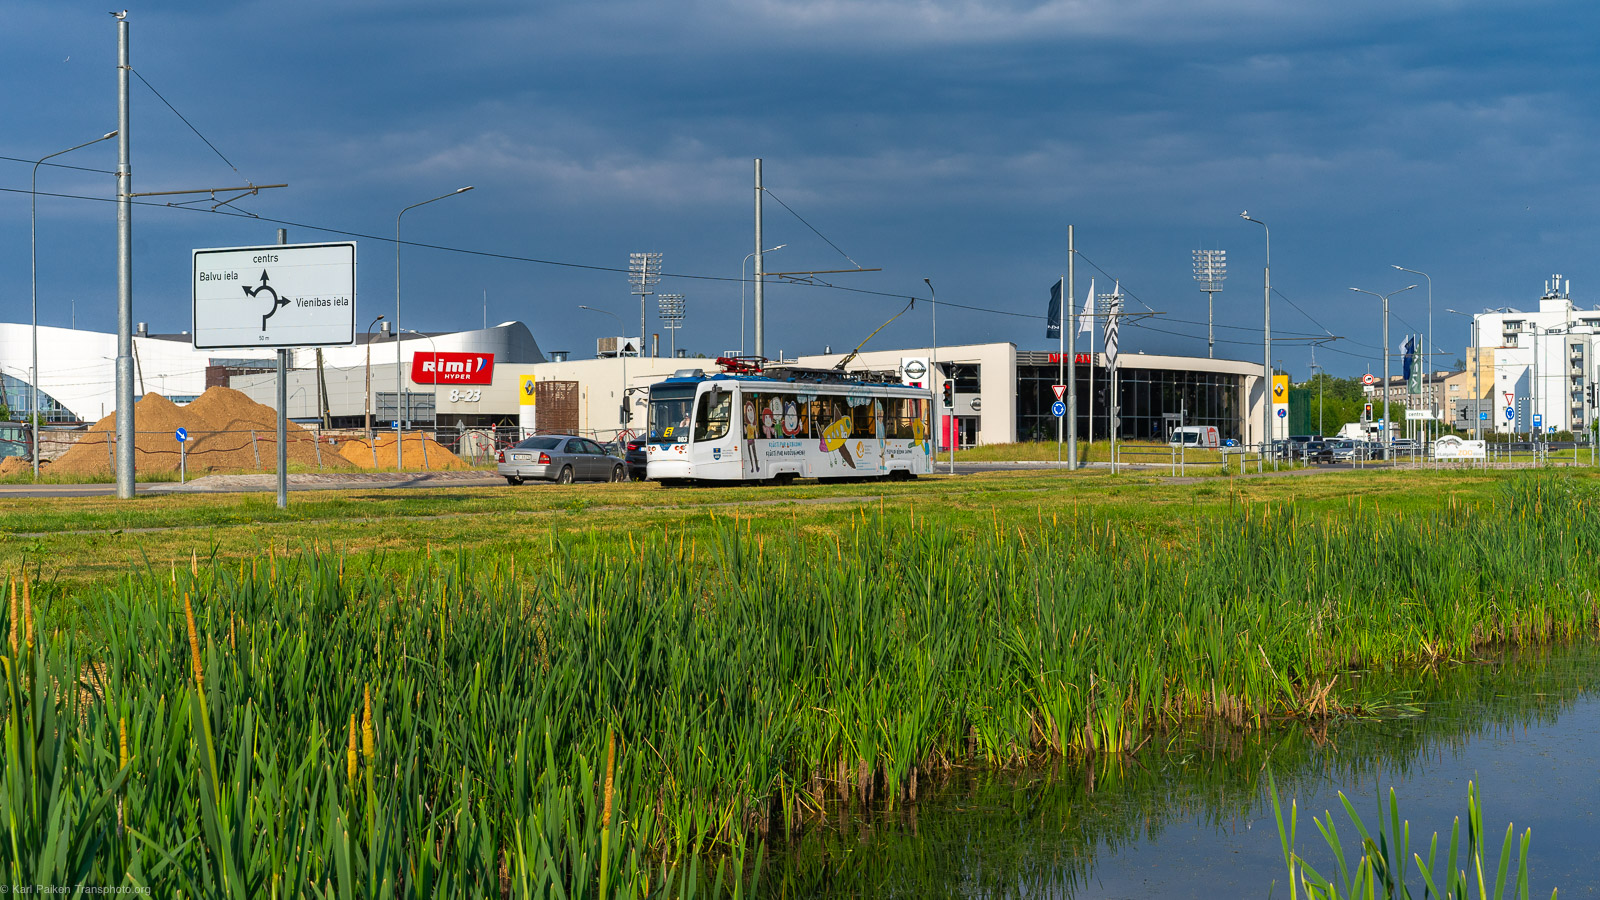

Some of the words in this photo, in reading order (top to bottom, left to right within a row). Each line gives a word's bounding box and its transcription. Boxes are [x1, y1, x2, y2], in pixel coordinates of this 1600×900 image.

[253, 253, 279, 263] centrs
[200, 271, 222, 282] Balvu
[224, 270, 238, 280] iela
[334, 296, 349, 306] iela
[1048, 353, 1091, 364] NISAN
[448, 389, 482, 404] 8-23
